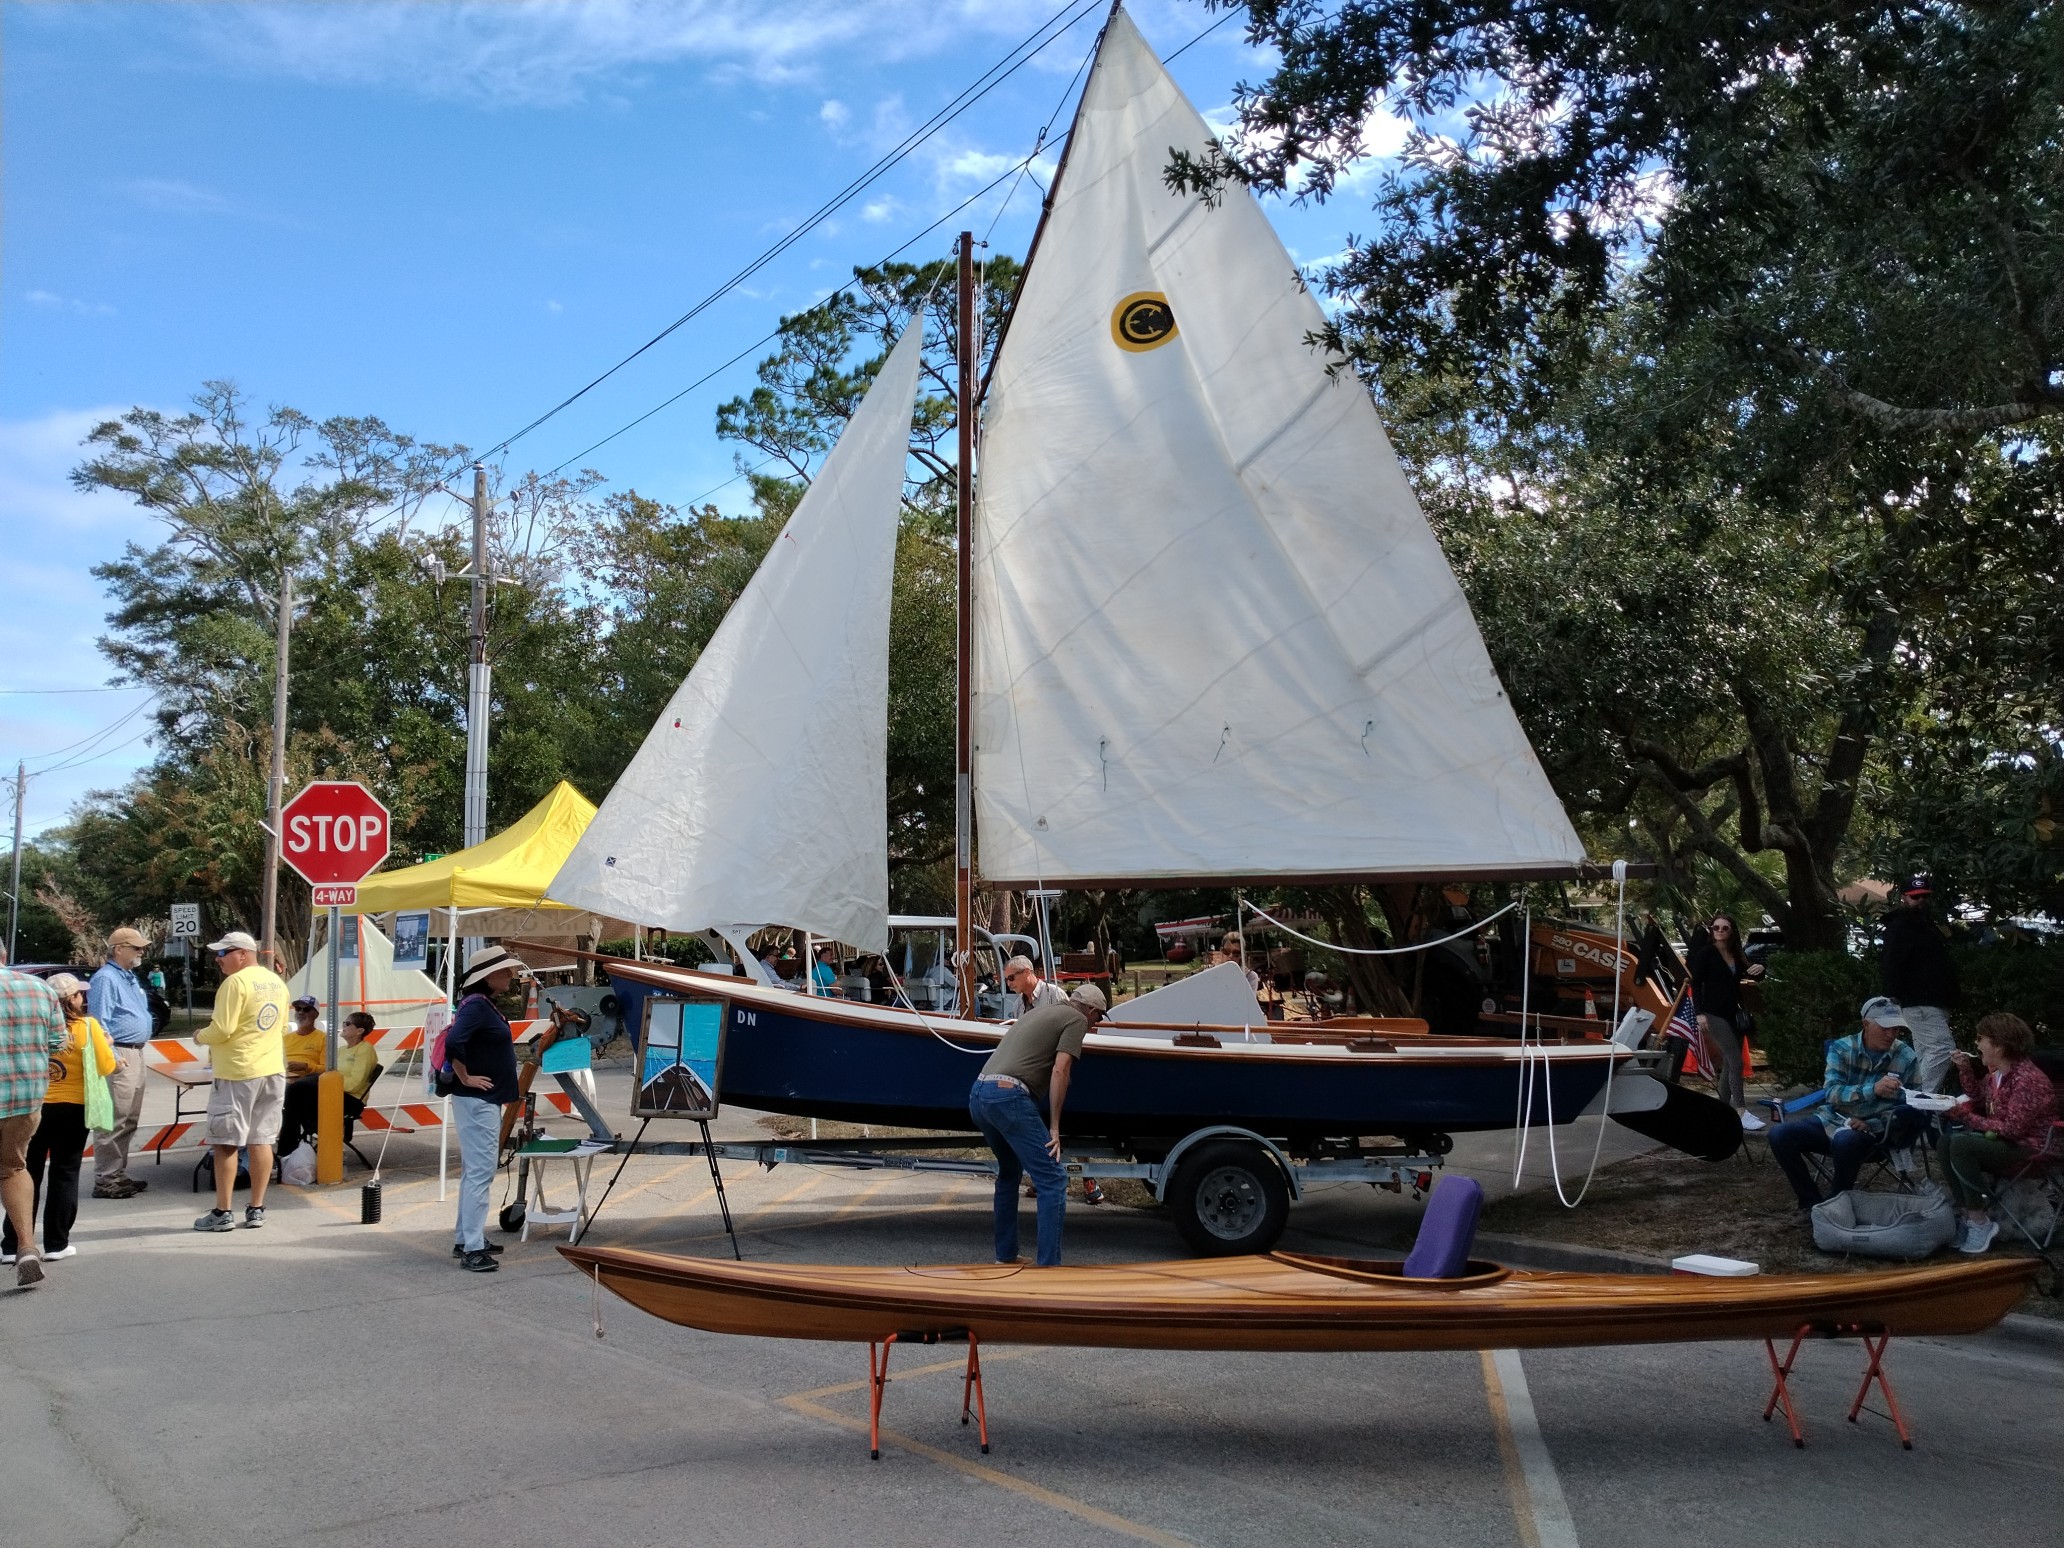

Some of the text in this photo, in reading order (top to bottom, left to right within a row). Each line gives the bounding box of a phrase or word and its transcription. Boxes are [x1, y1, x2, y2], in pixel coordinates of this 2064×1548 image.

[288, 815, 382, 853] STOP
[315, 889, 353, 903] 4-WAY
[174, 920, 197, 933] 20
[1551, 934, 1630, 974] 580 CASE
[737, 1009, 757, 1027] DN
